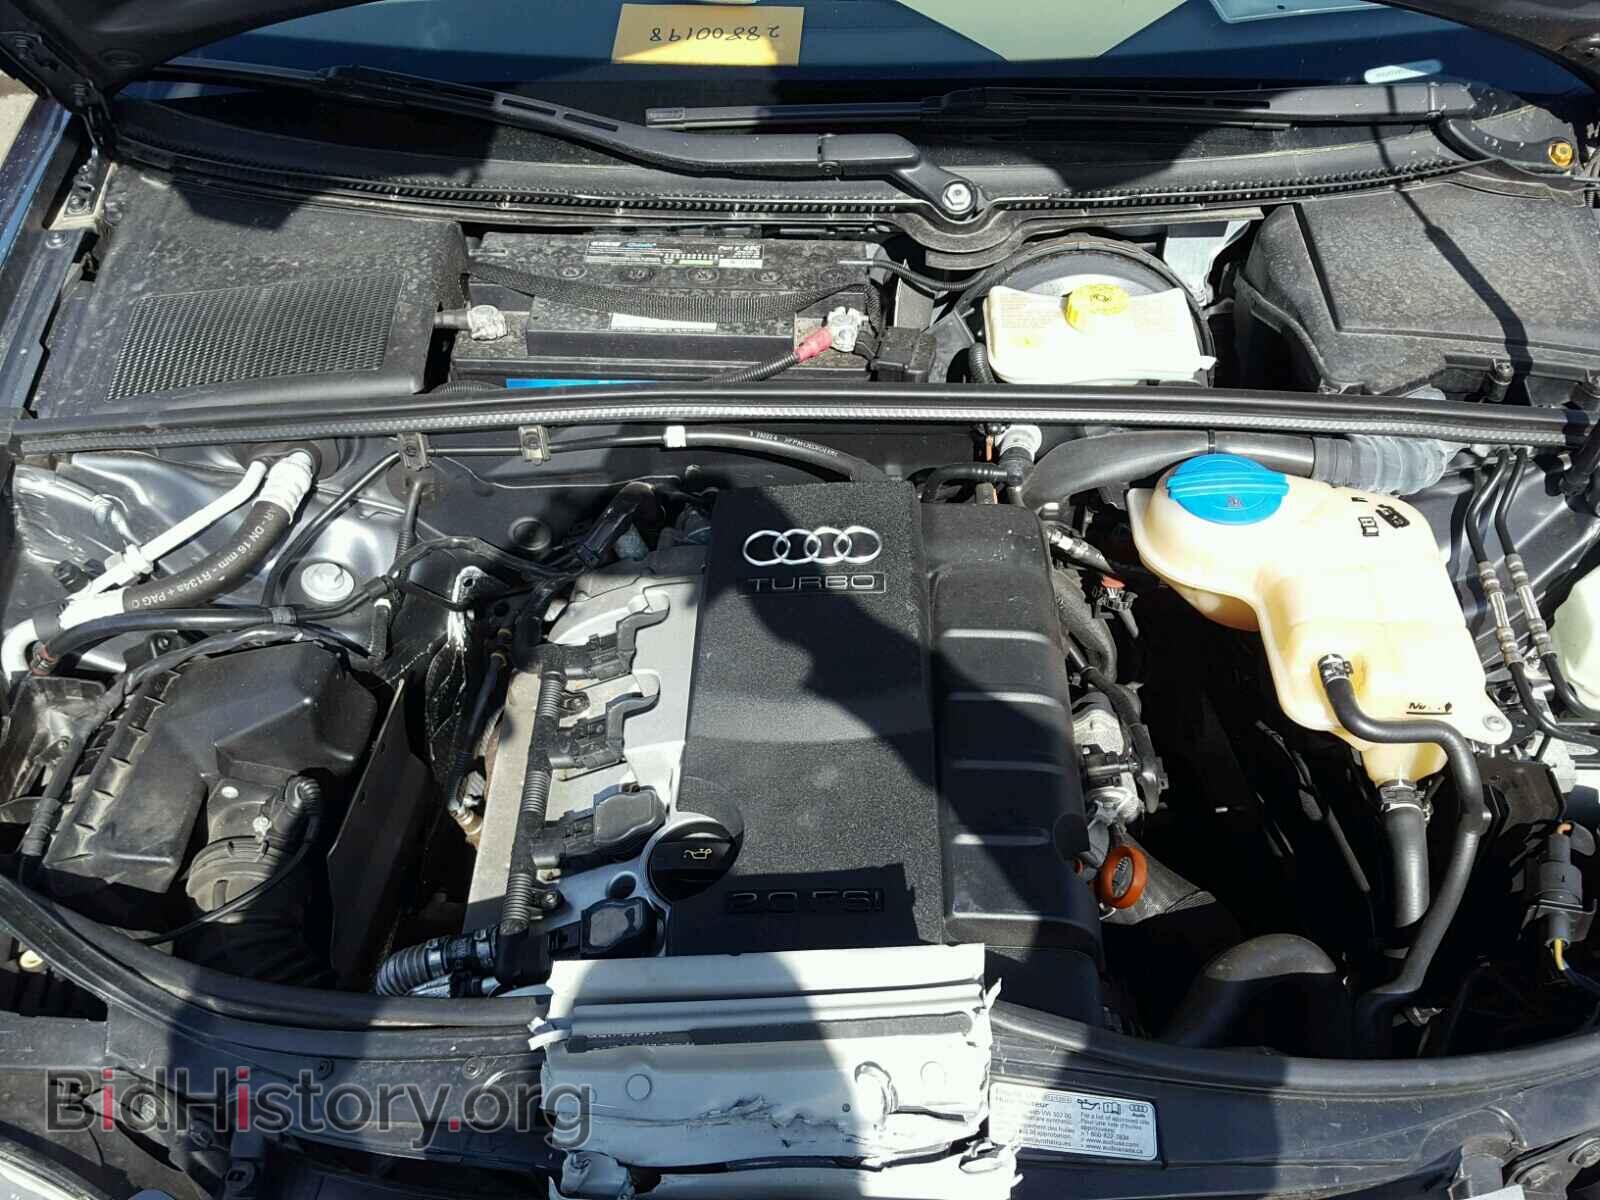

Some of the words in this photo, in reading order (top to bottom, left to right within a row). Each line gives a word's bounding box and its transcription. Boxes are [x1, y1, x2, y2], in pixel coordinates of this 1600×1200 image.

[649, 25, 781, 42] 28800198
[247, 526, 266, 544] DN
[236, 540, 253, 556] 16
[217, 552, 240, 570] mm
[746, 574, 876, 592] TURBO
[141, 593, 167, 608] PAG
